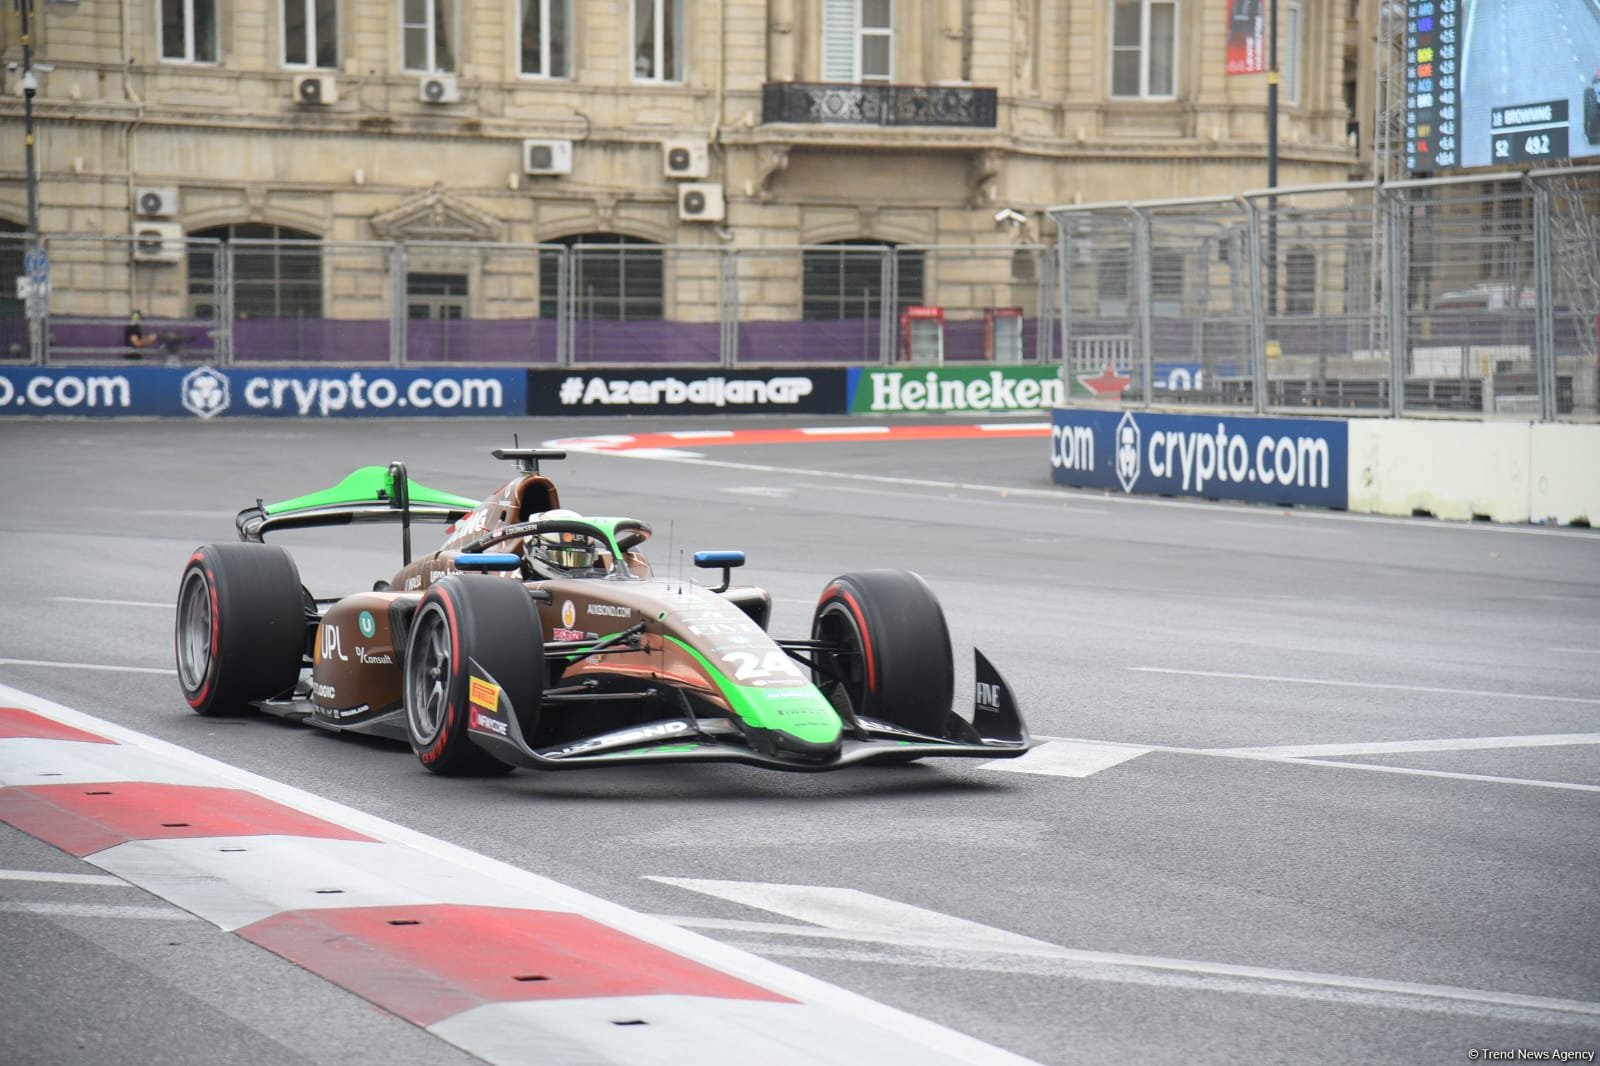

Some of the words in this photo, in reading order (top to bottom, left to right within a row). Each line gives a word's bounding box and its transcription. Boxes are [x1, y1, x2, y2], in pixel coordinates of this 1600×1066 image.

[244, 371, 503, 415] crypto.com
[560, 377, 812, 406] #AzerbaijanGP
[870, 371, 1063, 410] Heineken
[1148, 422, 1329, 492] crypto.com
[321, 623, 349, 661] UPL
[721, 650, 802, 681] 24
